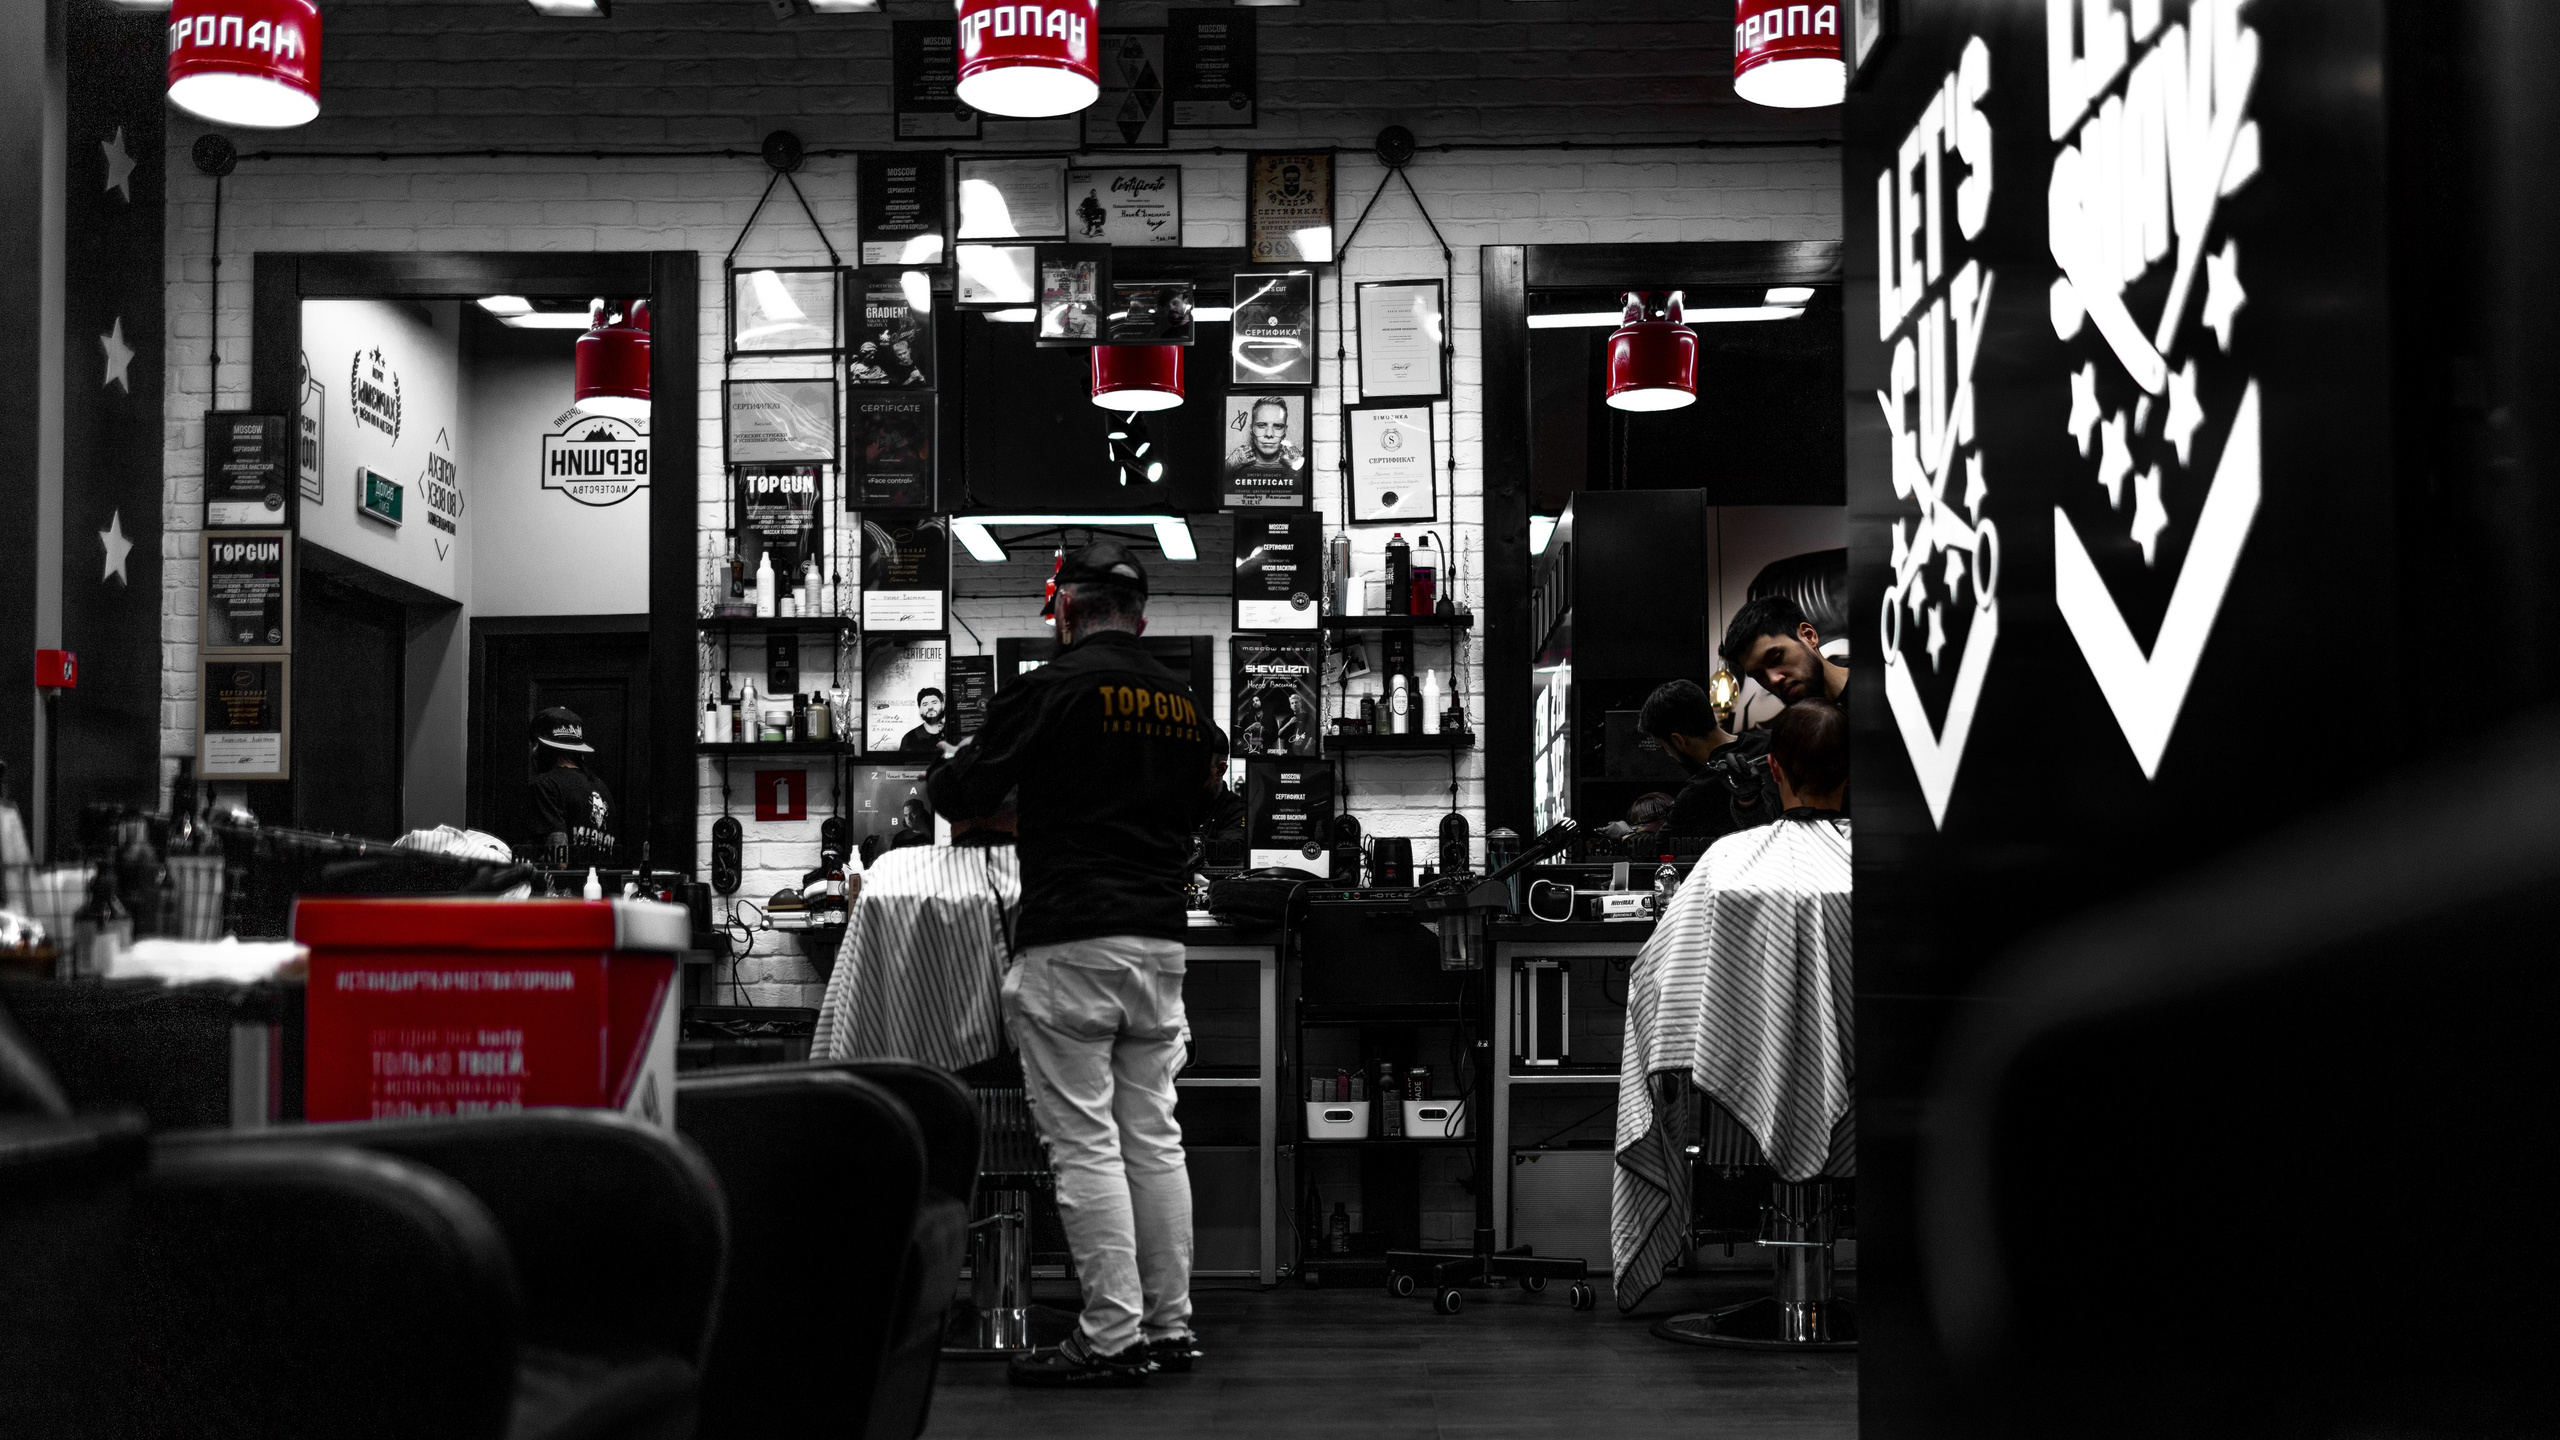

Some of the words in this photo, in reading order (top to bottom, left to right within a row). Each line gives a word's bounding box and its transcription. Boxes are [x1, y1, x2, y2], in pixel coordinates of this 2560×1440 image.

[961, 6, 1086, 50] ПРОПАН
[1198, 24, 1228, 33] MOSCOW
[1735, 5, 1836, 57] ПРОПА
[169, 15, 296, 60] ПРОПАН
[923, 37, 952, 46] MOSCOW
[887, 167, 917, 177] MOSCOW
[1004, 182, 1050, 190] CERTIFICATE
[1110, 176, 1167, 198] Certificate
[1878, 34, 1993, 342] LET'S
[1258, 208, 1324, 216] СЕРТИФИКАТ
[866, 306, 909, 319] GRADIENT
[1245, 328, 1302, 336] СЕРТИФИКАТ
[1890, 259, 1980, 500] CUT
[732, 402, 781, 410] СЕРТИФИКАТ
[860, 404, 921, 413] CERTIFICATE
[233, 425, 263, 434] MOSCOW
[1388, 435, 1395, 444] S
[1368, 456, 1416, 464] СЕРТИФИКАТ
[1234, 478, 1294, 486] CERTIFICATE
[1268, 523, 1289, 531] MOSCOW
[1276, 563, 1297, 571] ВАСИЛИЙ
[903, 647, 943, 660] CERTIFICATE
[1098, 684, 1198, 727] TOPGUN
[871, 772, 879, 780] Z
[909, 787, 918, 795] A
[891, 817, 899, 826] B
[1286, 813, 1307, 821] ВАСИЛИЙ
